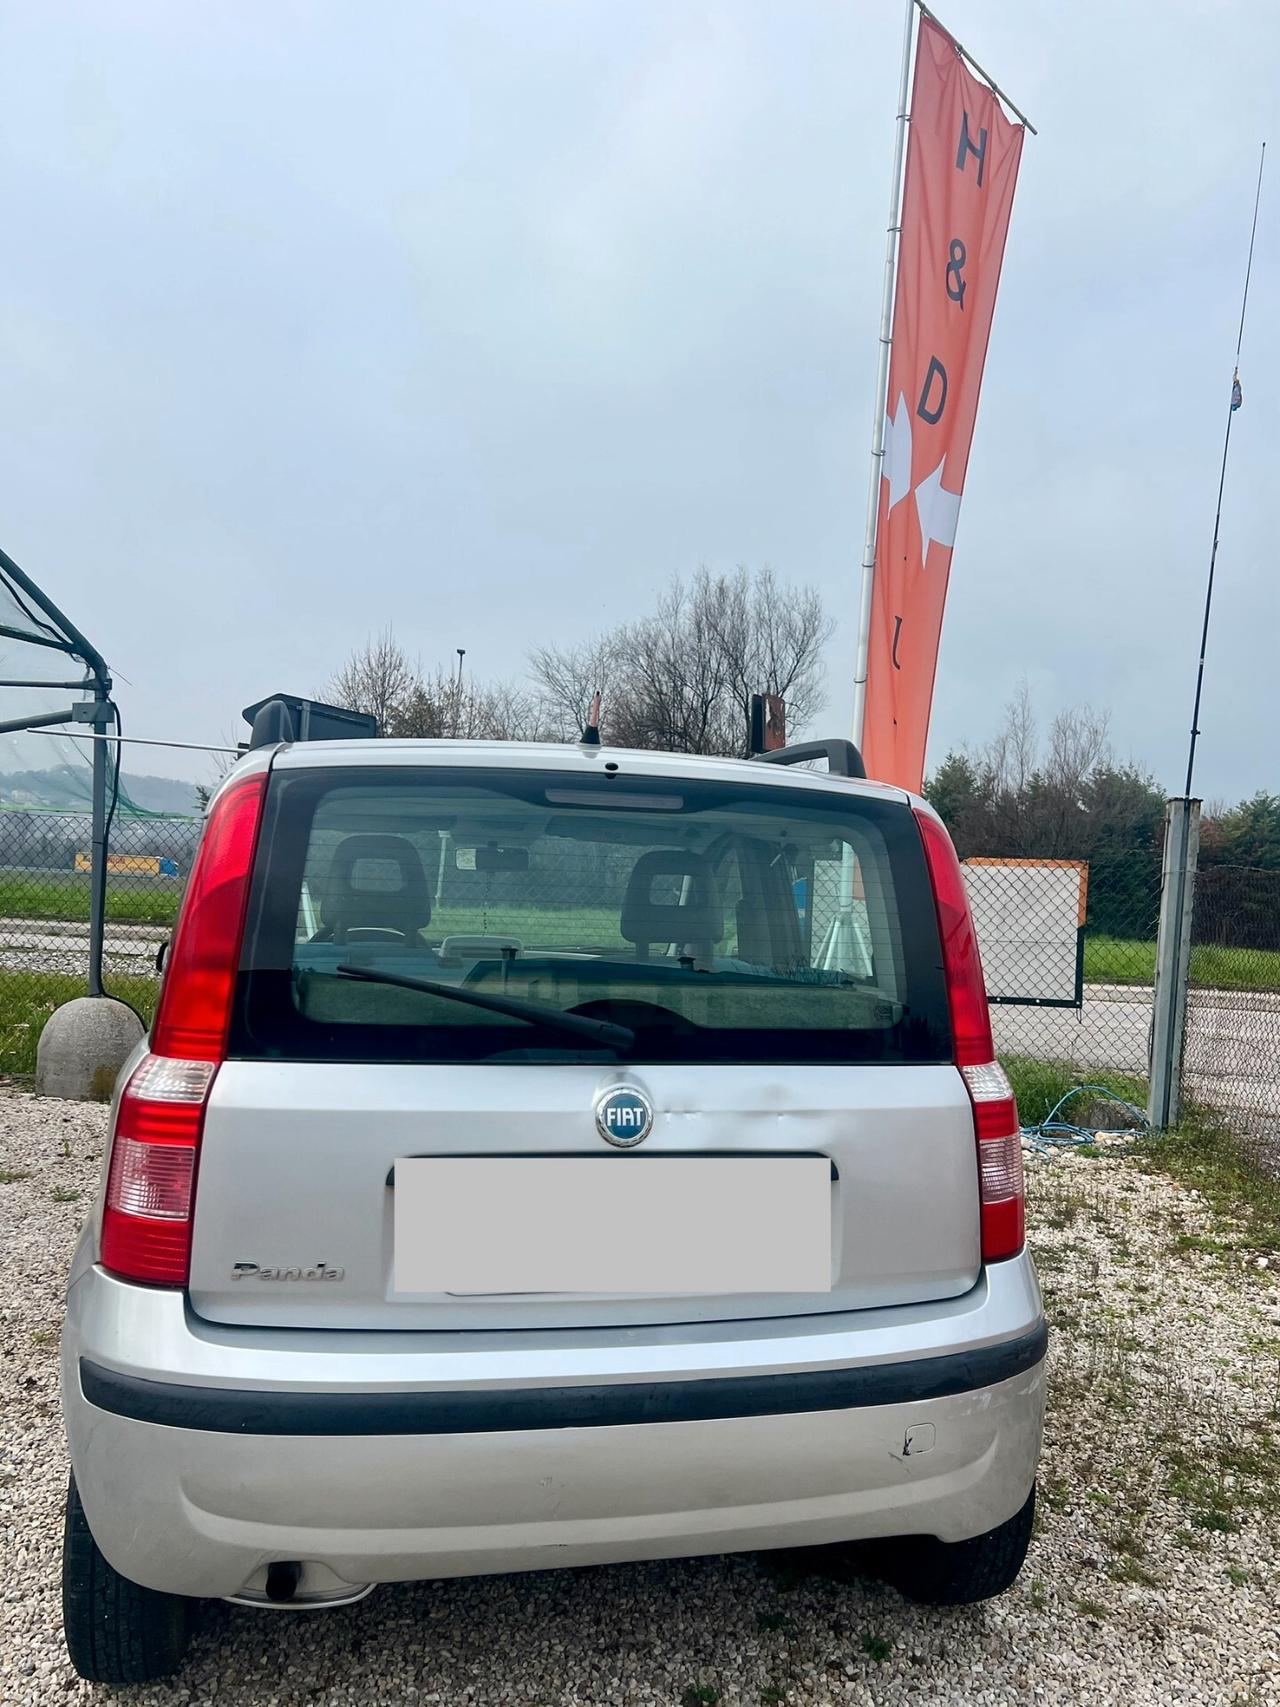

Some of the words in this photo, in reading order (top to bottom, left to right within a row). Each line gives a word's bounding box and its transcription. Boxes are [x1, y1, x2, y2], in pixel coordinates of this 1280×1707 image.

[945, 238, 967, 312] &
[917, 355, 948, 425] D
[606, 1107, 644, 1127] FIAT
[231, 1261, 345, 1282] Panda
